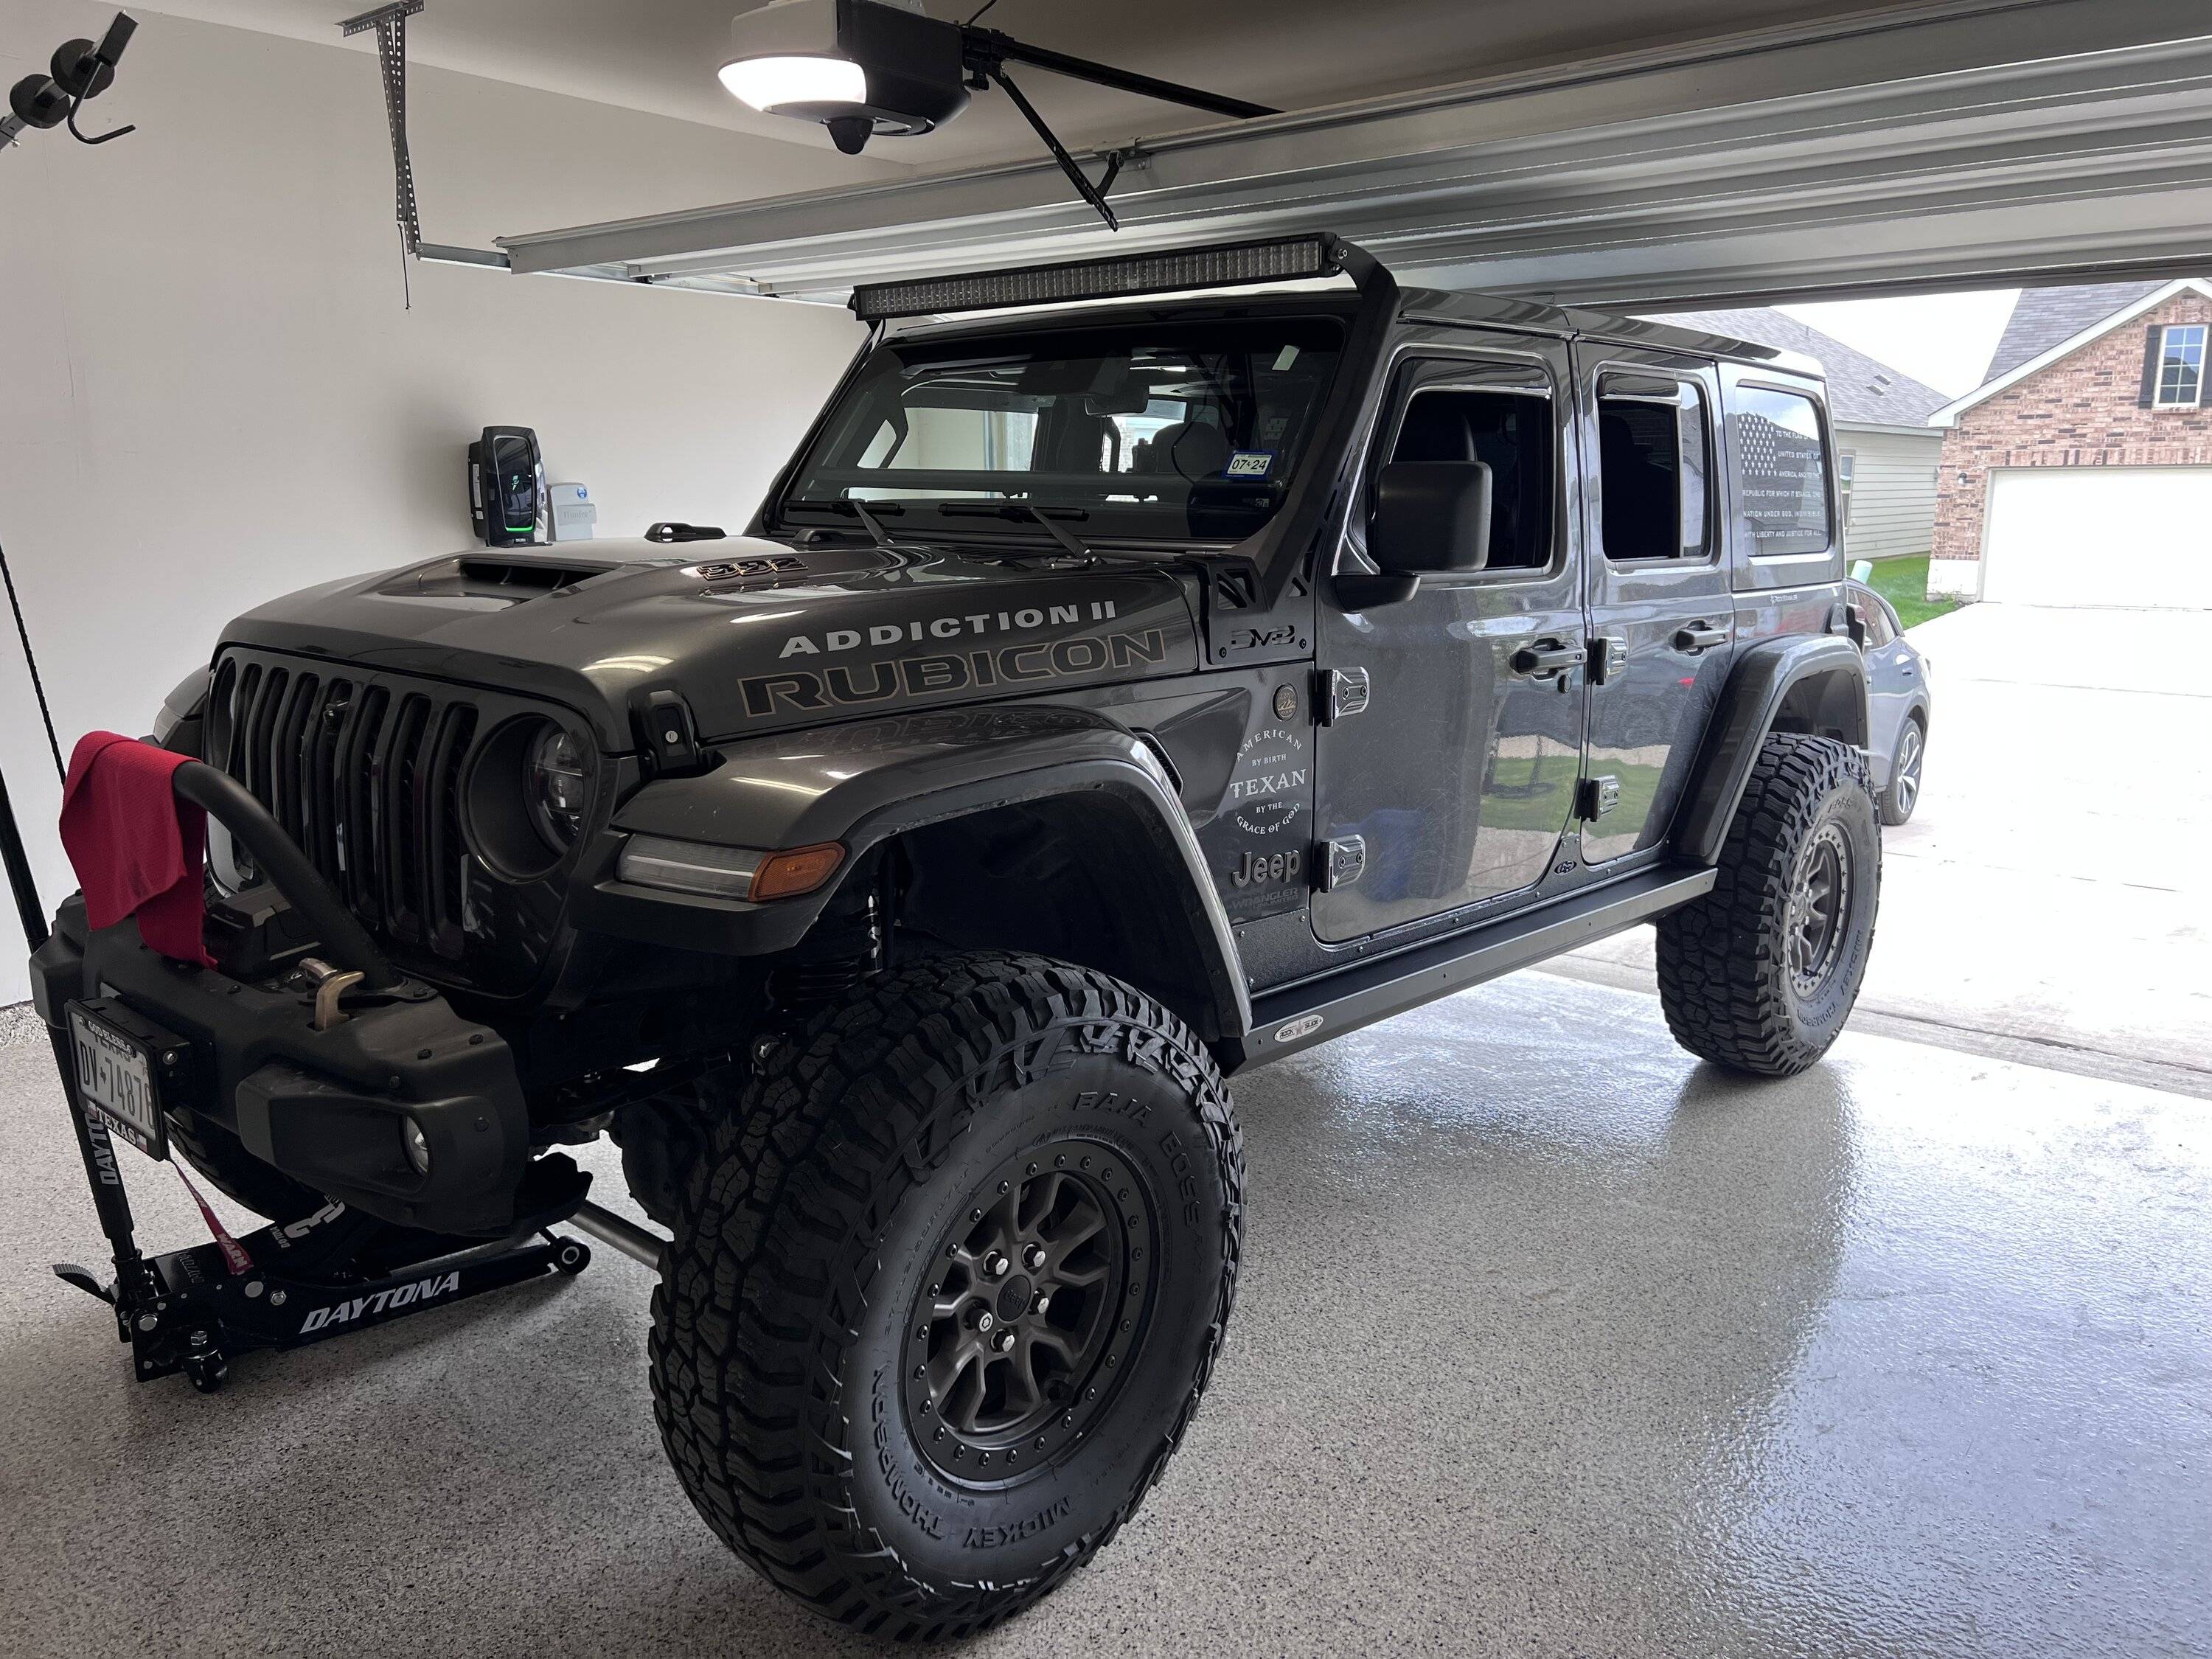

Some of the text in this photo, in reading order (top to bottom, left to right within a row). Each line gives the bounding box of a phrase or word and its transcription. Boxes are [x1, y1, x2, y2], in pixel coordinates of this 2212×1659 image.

[1796, 451, 1812, 459] STATES
[1756, 530, 1775, 538] LIBERTY
[696, 557, 809, 581] 392
[778, 600, 1117, 658] ADDICTION II
[737, 629, 1167, 718] RUBICON
[1236, 728, 1303, 762] AMERICAN
[1251, 753, 1287, 767] BY BIRTH
[1230, 768, 1307, 799] TEXAN
[1237, 802, 1301, 835] GRACE OF GOD
[1256, 801, 1283, 814] BY THE
[1232, 849, 1301, 887] Jeep
[1231, 887, 1298, 909] WRANGLER
[97, 1107, 138, 1145] TEXAS
[1074, 1091, 1158, 1129] BAJA
[1161, 1130, 1202, 1228] BOSS
[217, 1233, 247, 1268] WARN
[299, 1271, 459, 1334] DAYTONA
[872, 1363, 945, 1543] THOMPSON
[963, 1495, 1073, 1549] MICKEY
